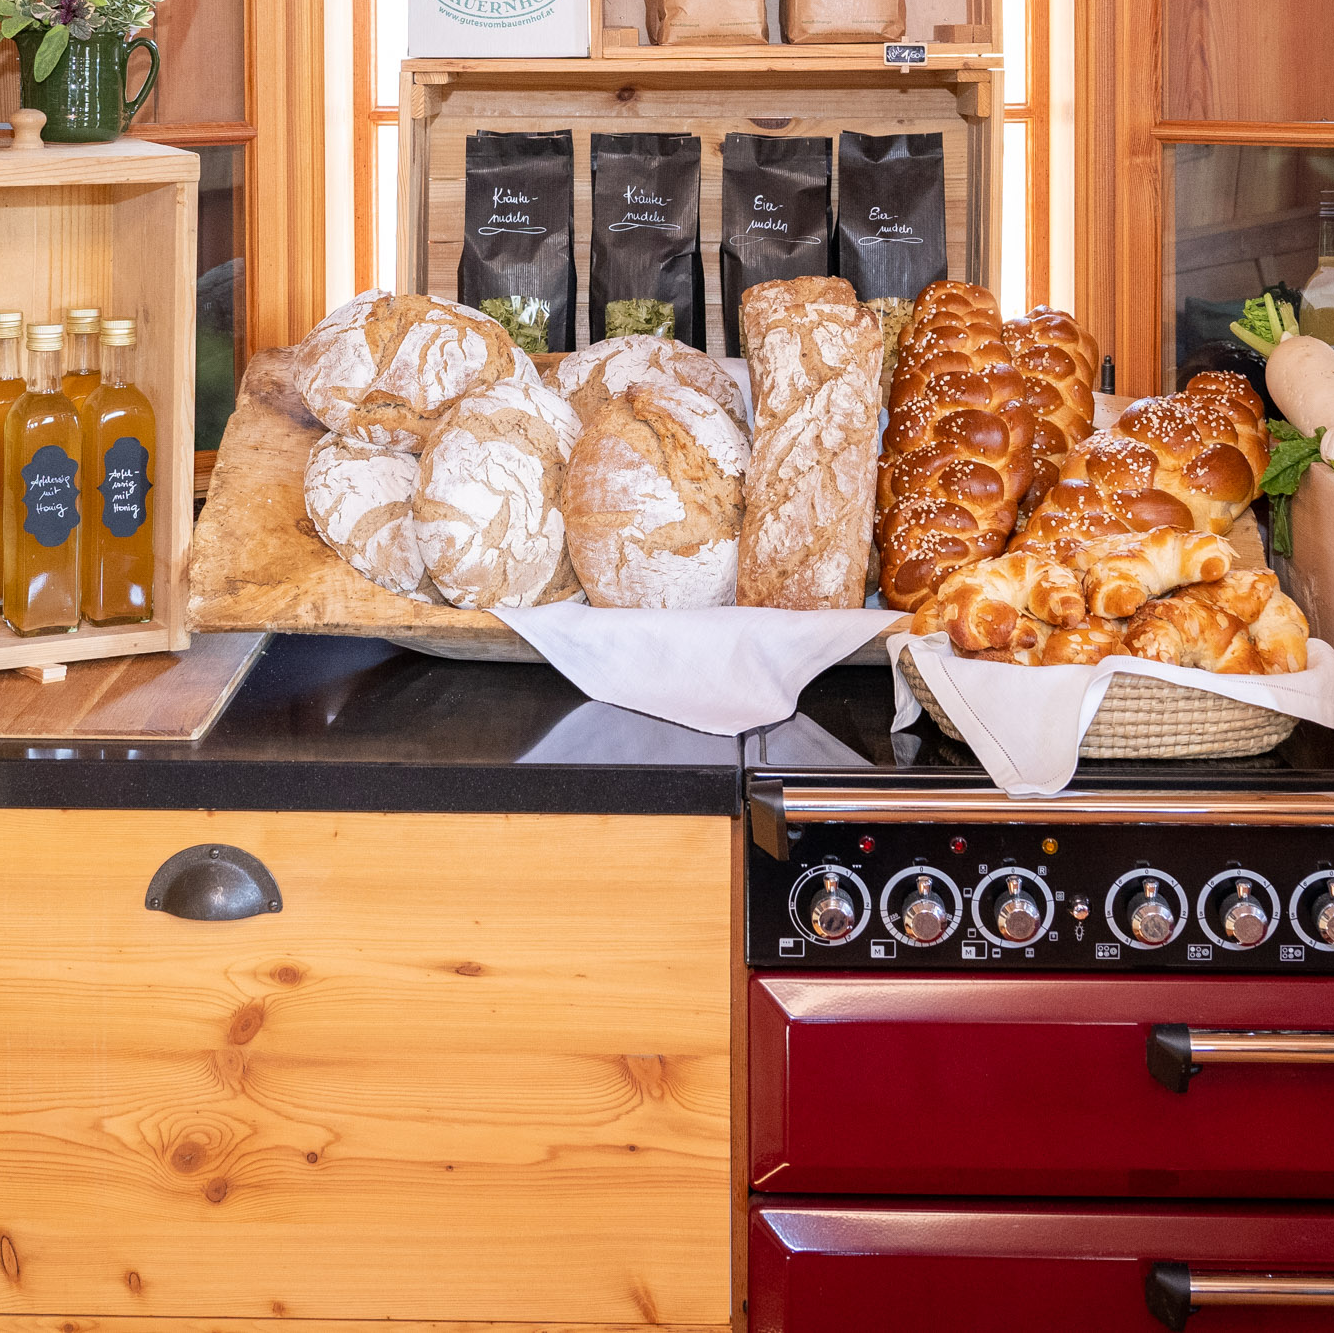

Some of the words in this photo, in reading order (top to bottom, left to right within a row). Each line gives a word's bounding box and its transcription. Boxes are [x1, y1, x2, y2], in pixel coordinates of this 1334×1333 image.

[437, 4, 555, 29] www.gutesvombauernhof.at
[38, 486, 62, 501] mit
[111, 490, 132, 503] mit
[35, 502, 69, 518] Honig
[113, 502, 141, 519] Honig
[1038, 867, 1046, 875] R
[873, 947, 882, 956] M
[964, 948, 973, 956] M
